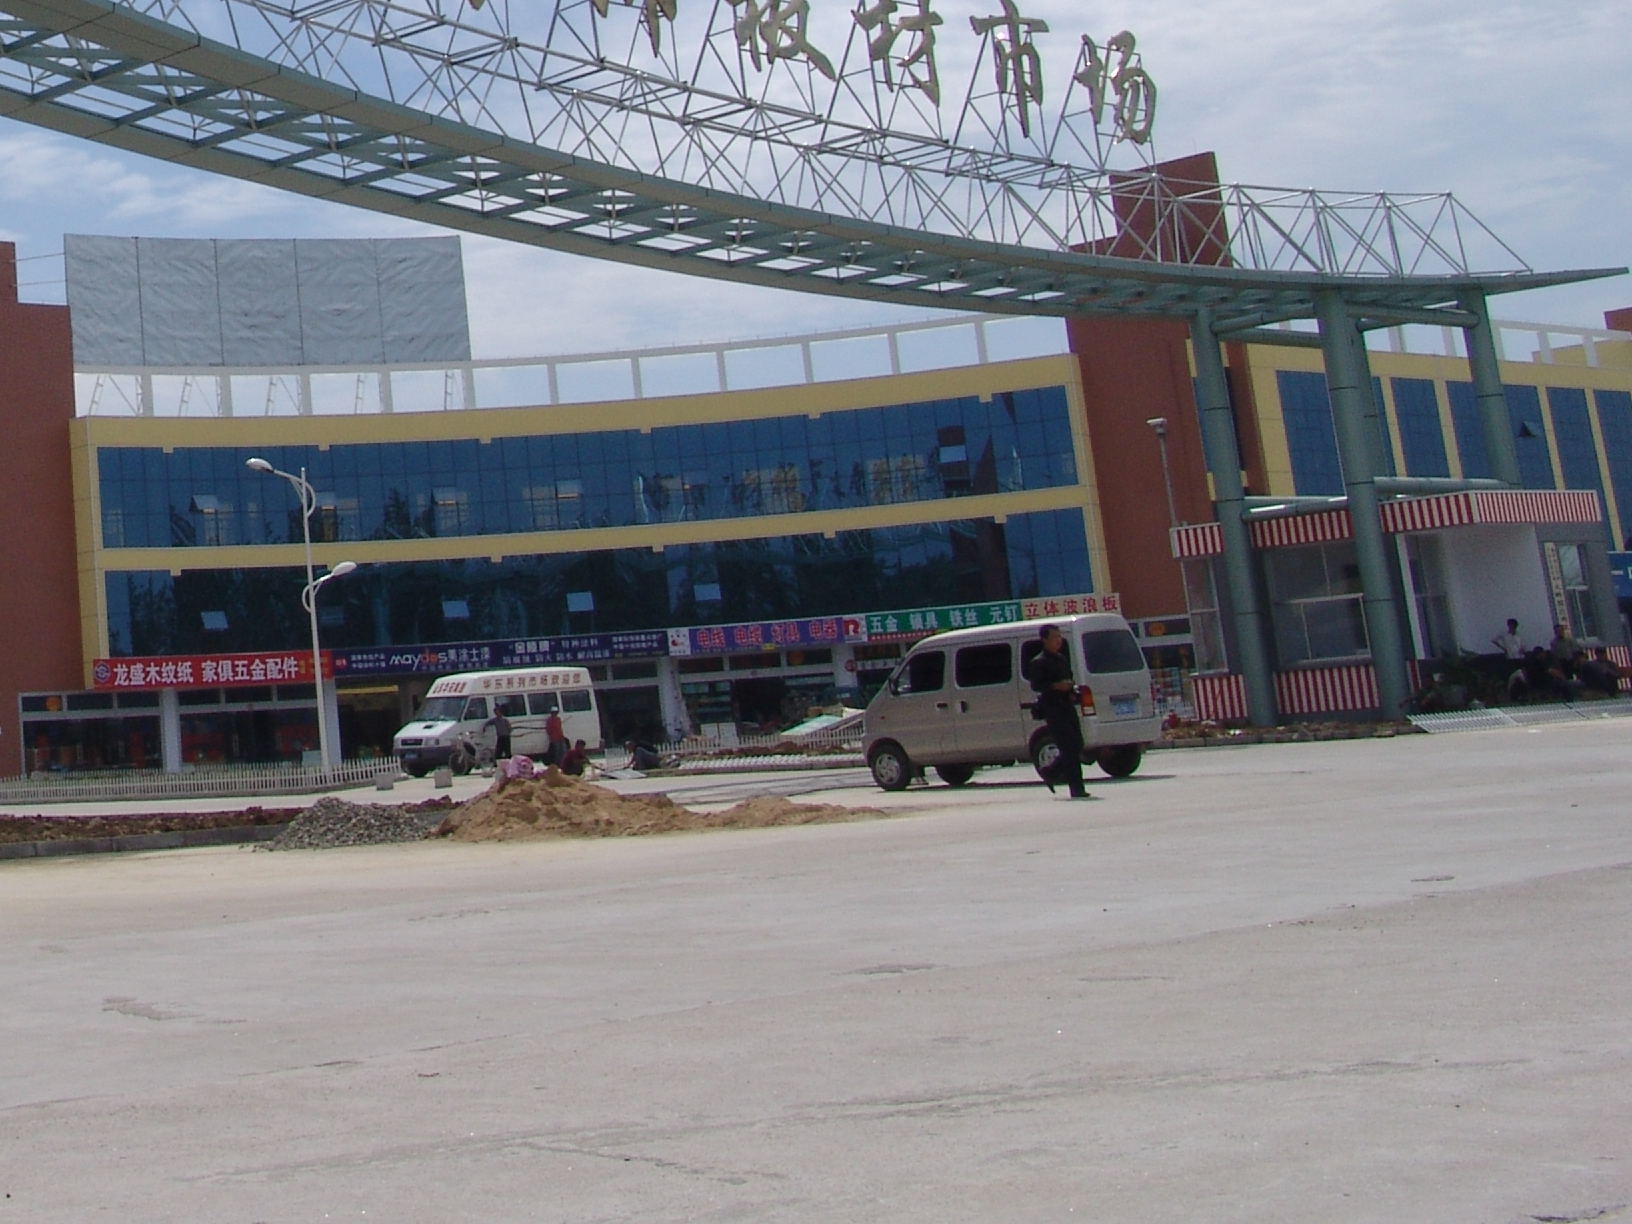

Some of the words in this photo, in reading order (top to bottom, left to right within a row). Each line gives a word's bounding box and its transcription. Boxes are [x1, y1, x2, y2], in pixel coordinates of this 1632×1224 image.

[1024, 595, 1119, 618] 立体波浪板
[869, 615, 898, 634] 五金
[113, 660, 194, 686] 龙盛木纹纸
